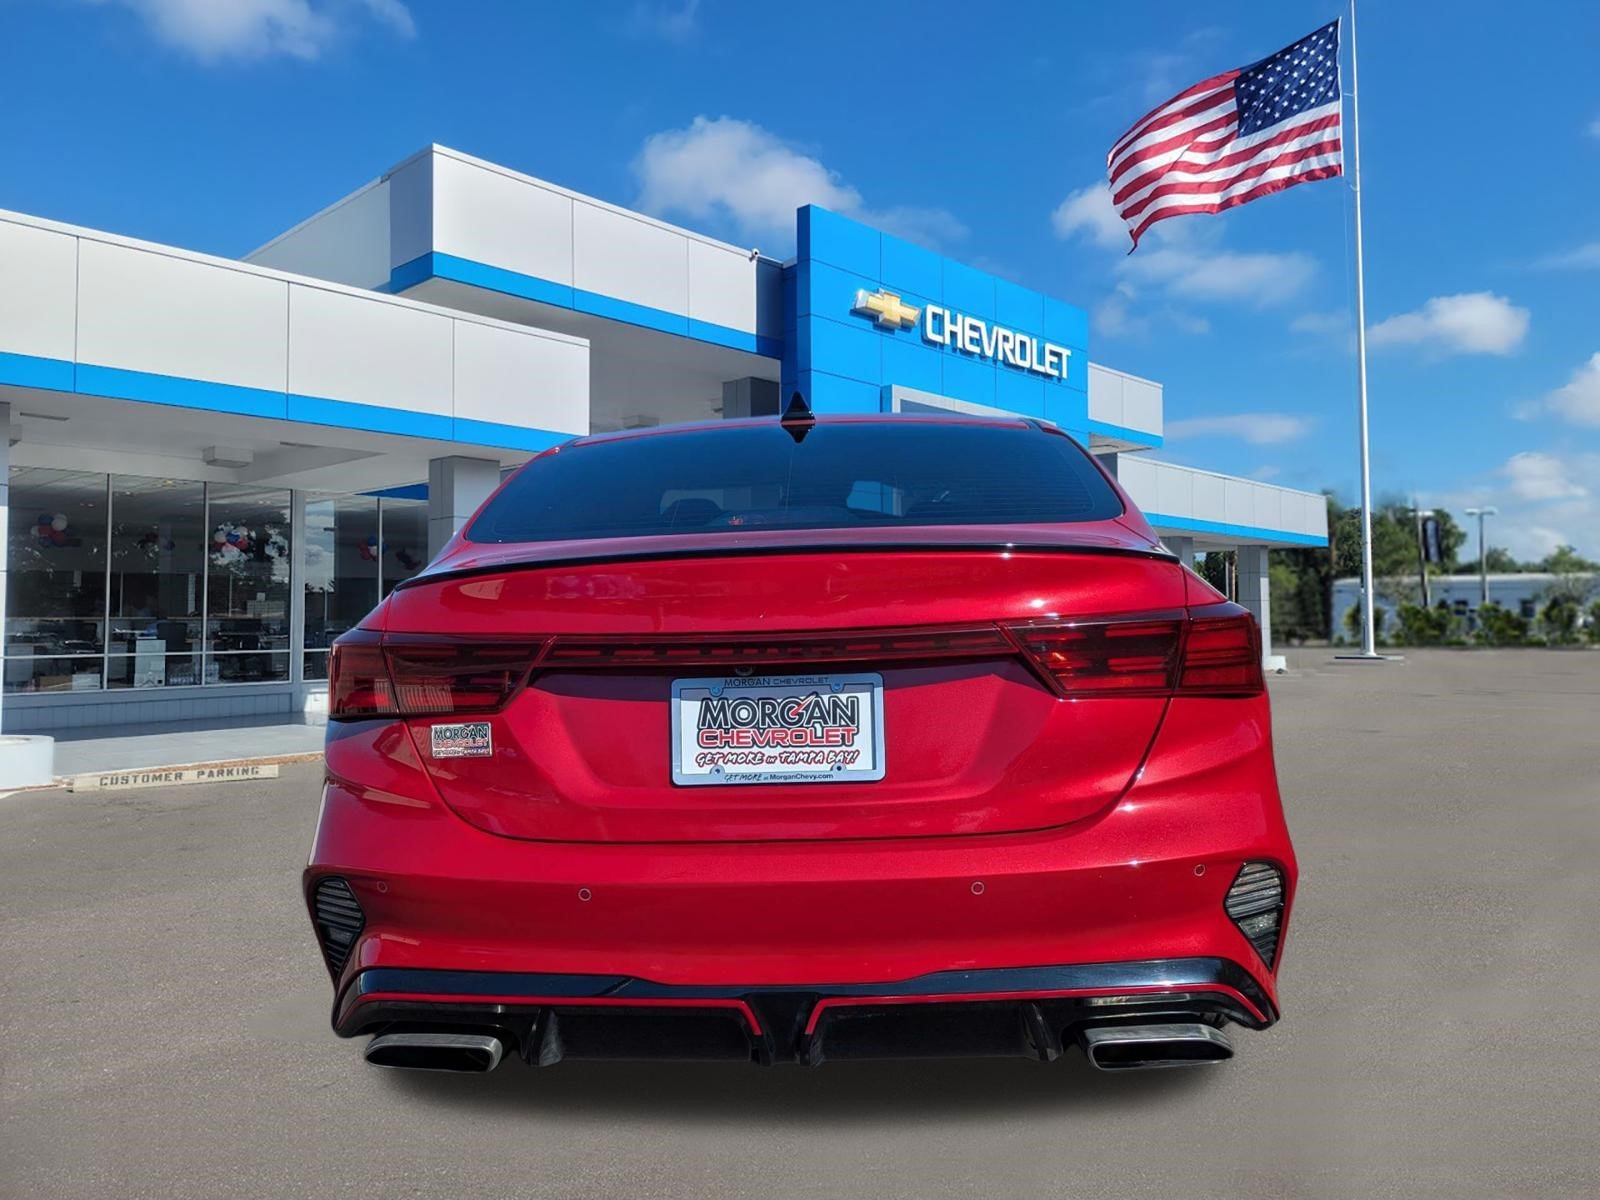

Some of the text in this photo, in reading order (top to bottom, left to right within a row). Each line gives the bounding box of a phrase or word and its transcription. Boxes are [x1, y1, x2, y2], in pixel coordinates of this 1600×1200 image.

[924, 303, 1072, 380] CHEVROLET
[724, 676, 830, 687] MORGAN CHEVROLET
[698, 693, 860, 729] MORGAN
[434, 726, 488, 739] MORGAN
[698, 726, 860, 749] CHEVROLET
[696, 752, 724, 768] GET
[723, 751, 765, 766] MORE
[778, 750, 825, 765] TAMPA
[826, 749, 861, 765] BAY!
[99, 766, 260, 787] CUSTOMER PARKING
[769, 772, 834, 781] MorganChevy.com
